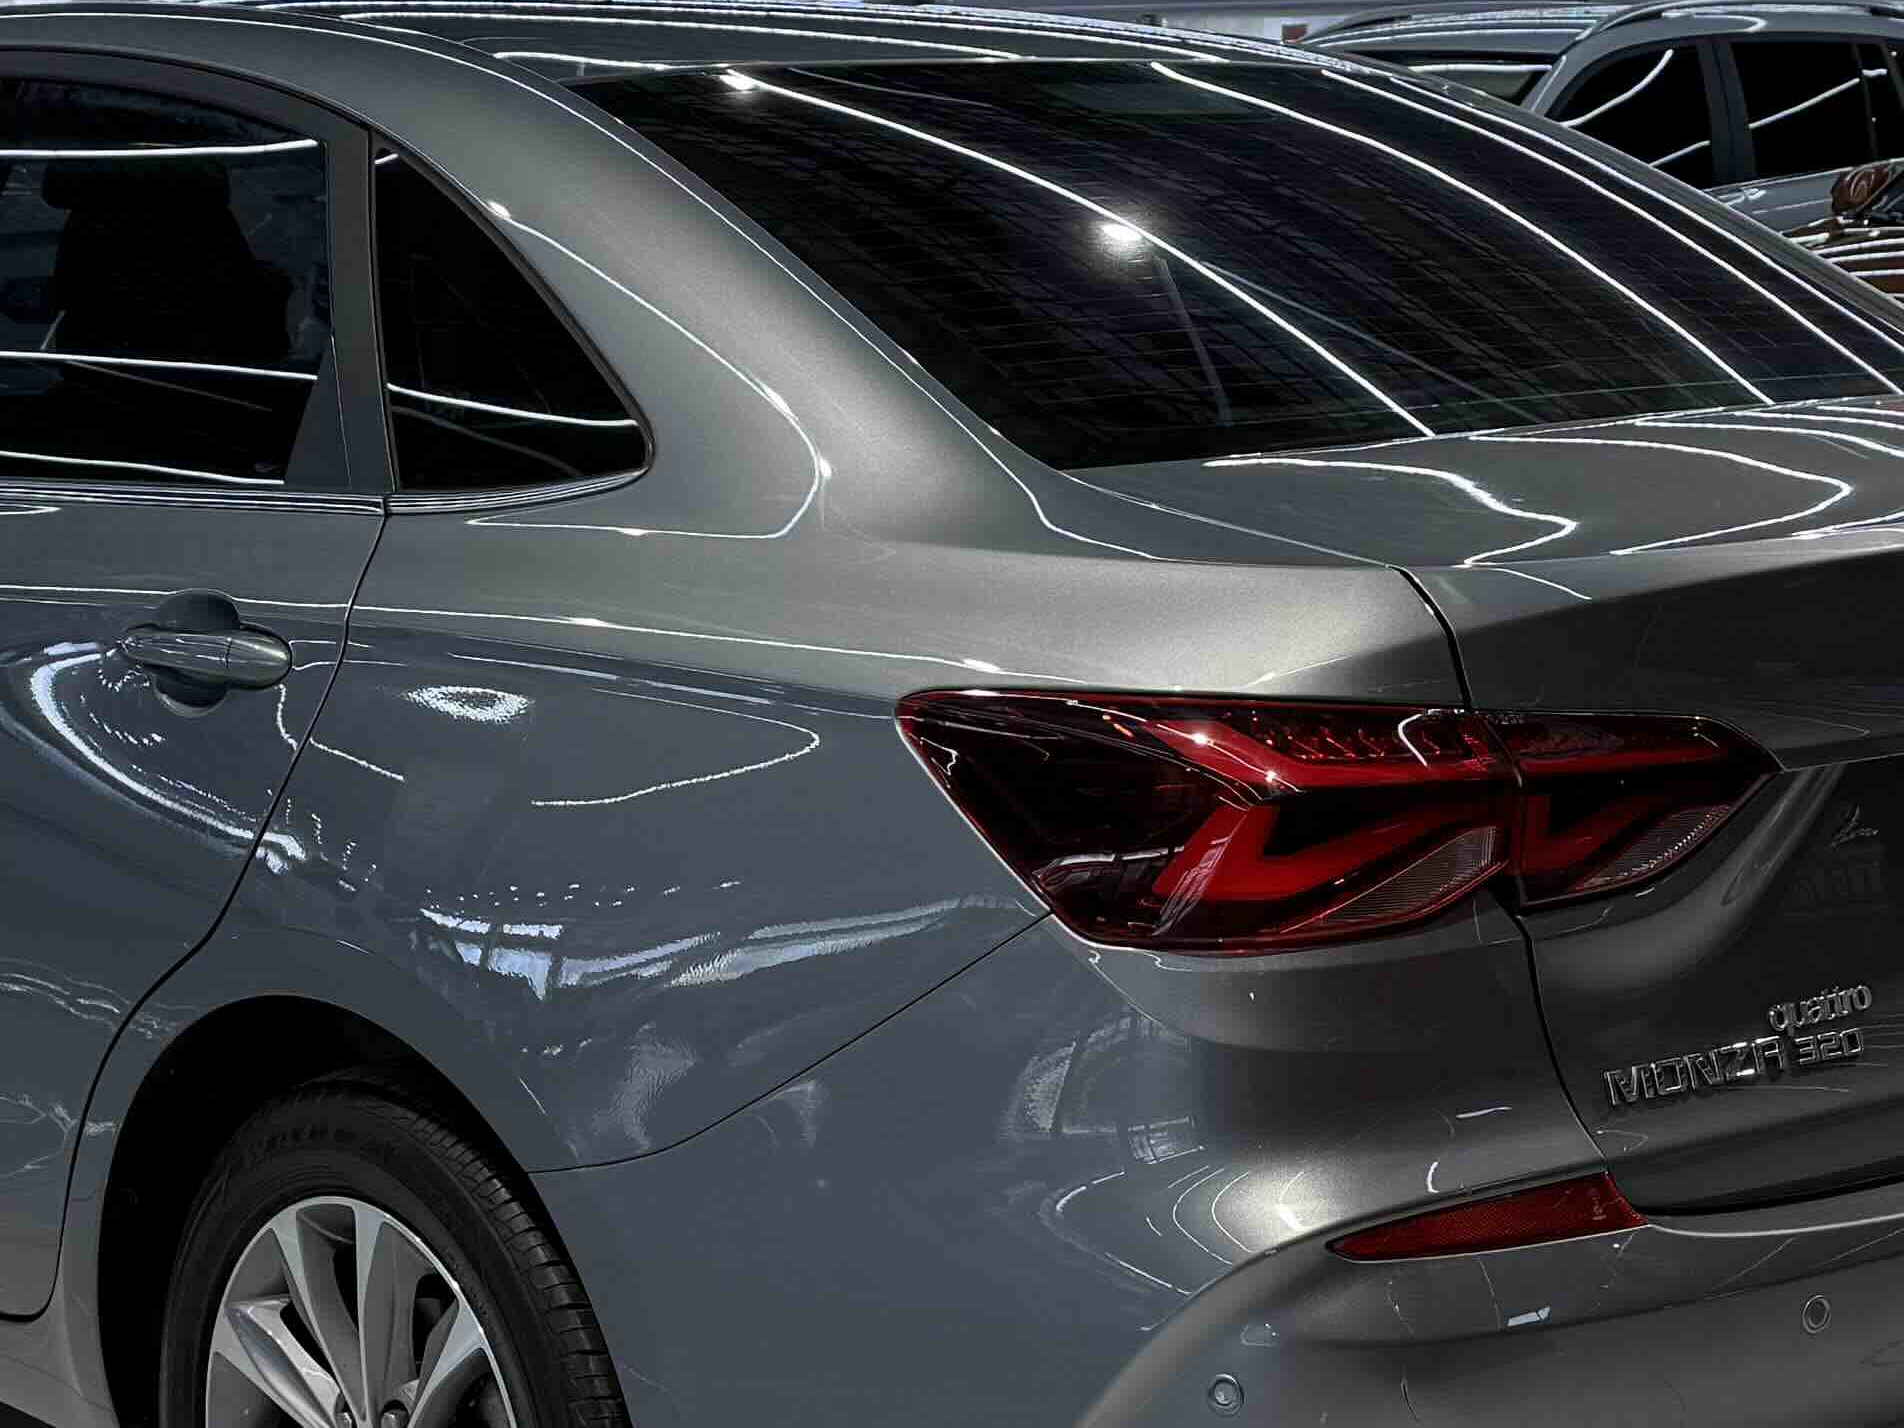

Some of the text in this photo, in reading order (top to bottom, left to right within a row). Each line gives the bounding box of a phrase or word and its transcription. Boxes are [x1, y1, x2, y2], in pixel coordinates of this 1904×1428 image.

[1768, 985, 1872, 1036] quattro
[1604, 1027, 1864, 1105] MONZA 320
